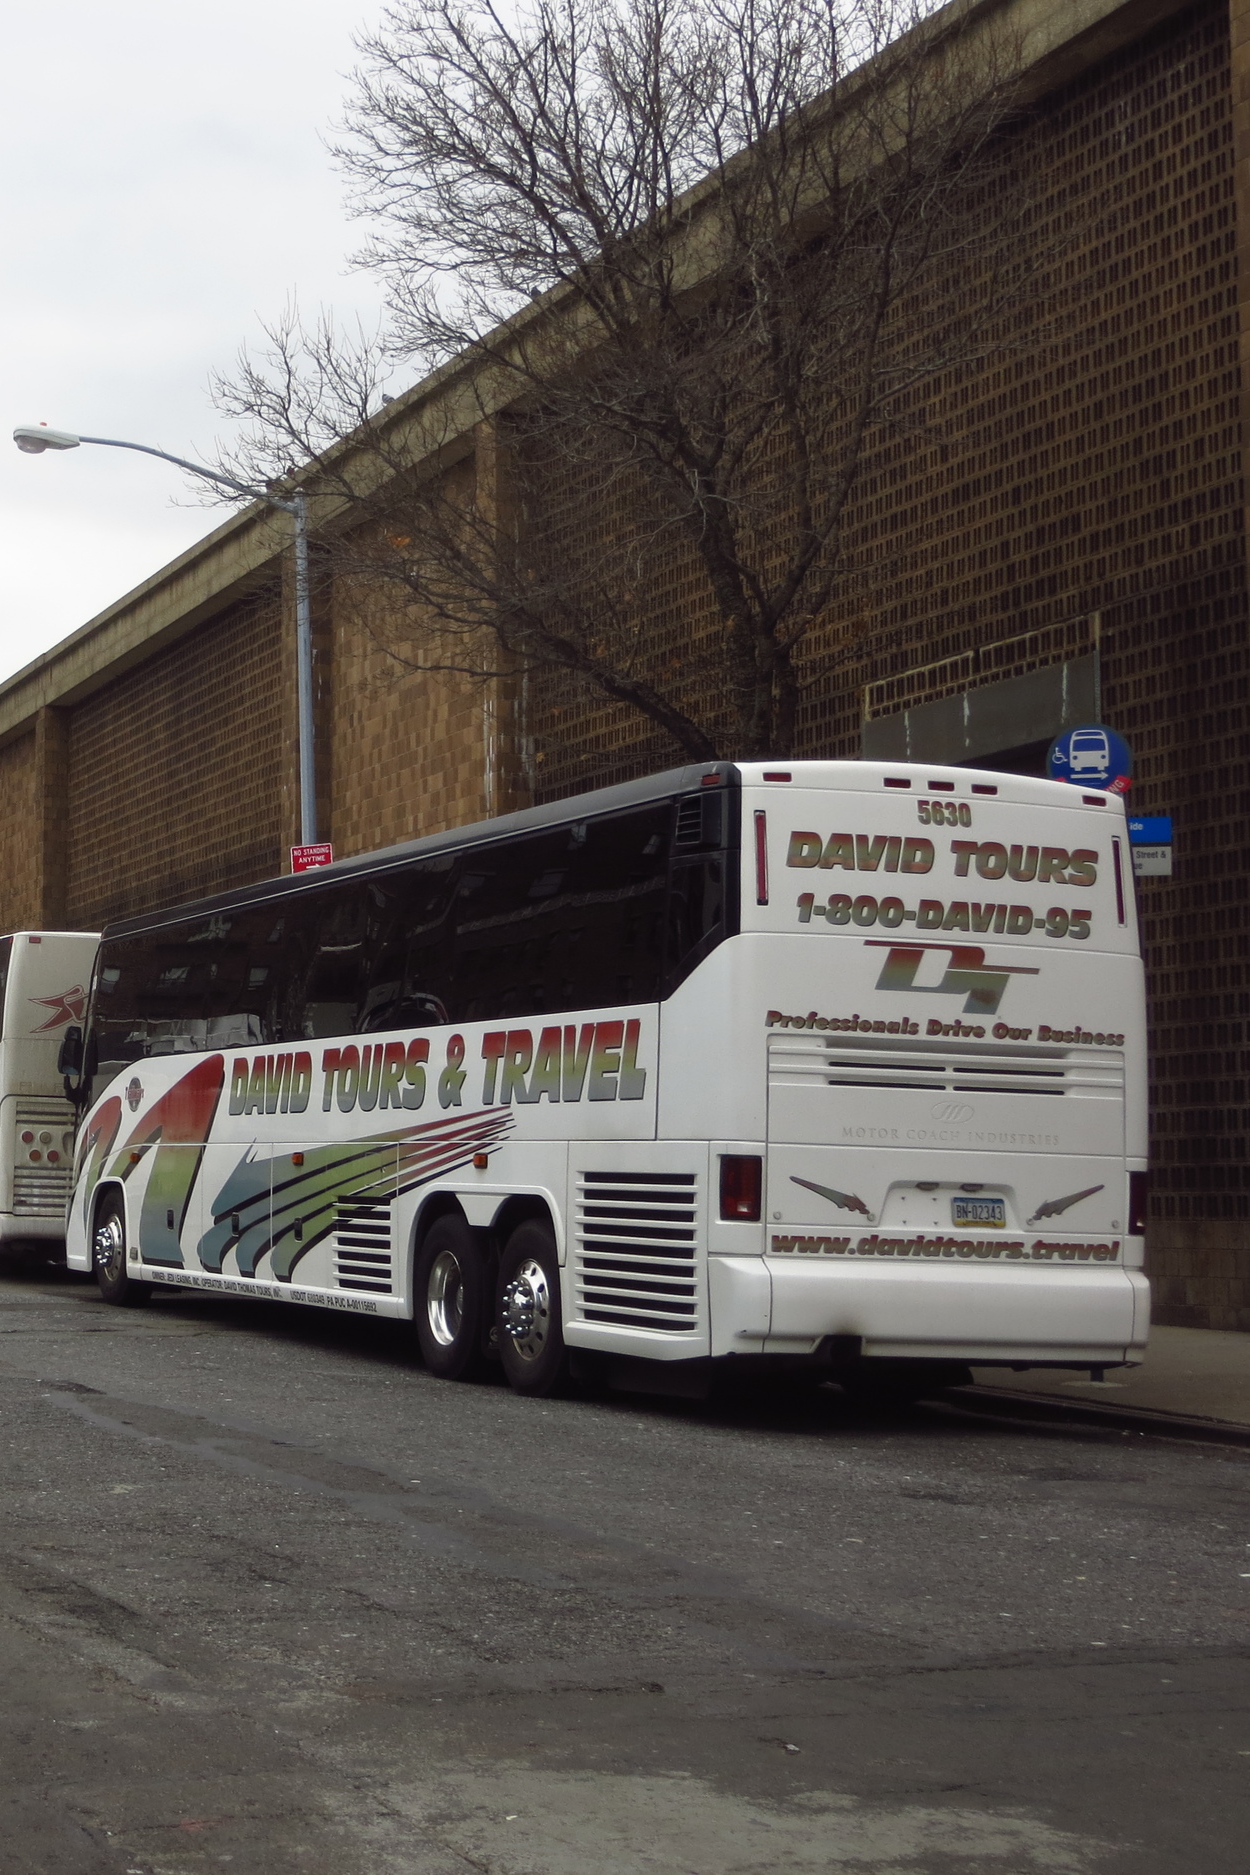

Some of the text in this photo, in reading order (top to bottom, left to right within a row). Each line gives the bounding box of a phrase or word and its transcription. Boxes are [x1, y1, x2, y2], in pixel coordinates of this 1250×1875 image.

[917, 800, 972, 828] 5630
[299, 855, 325, 863] ANYTIME
[303, 847, 329, 855] STANDING
[786, 830, 1099, 887] DAVID TOURS
[1136, 850, 1158, 859] Street
[796, 892, 1092, 940] 1-800-DAVID-95
[765, 1009, 1125, 1047] Professionals Drive Our Business
[228, 1018, 647, 1117] DAVID TOURS & TRAVEL
[841, 1126, 1060, 1146] MOTOR COACH INDUSTRIES
[771, 1234, 1121, 1262] www.davidtours.travel
[224, 1281, 237, 1291] DAVID
[238, 1283, 256, 1294] THOMAS
[290, 1290, 307, 1301] USDOT
[327, 1296, 335, 1306] PA
[335, 1297, 346, 1308] PUC
